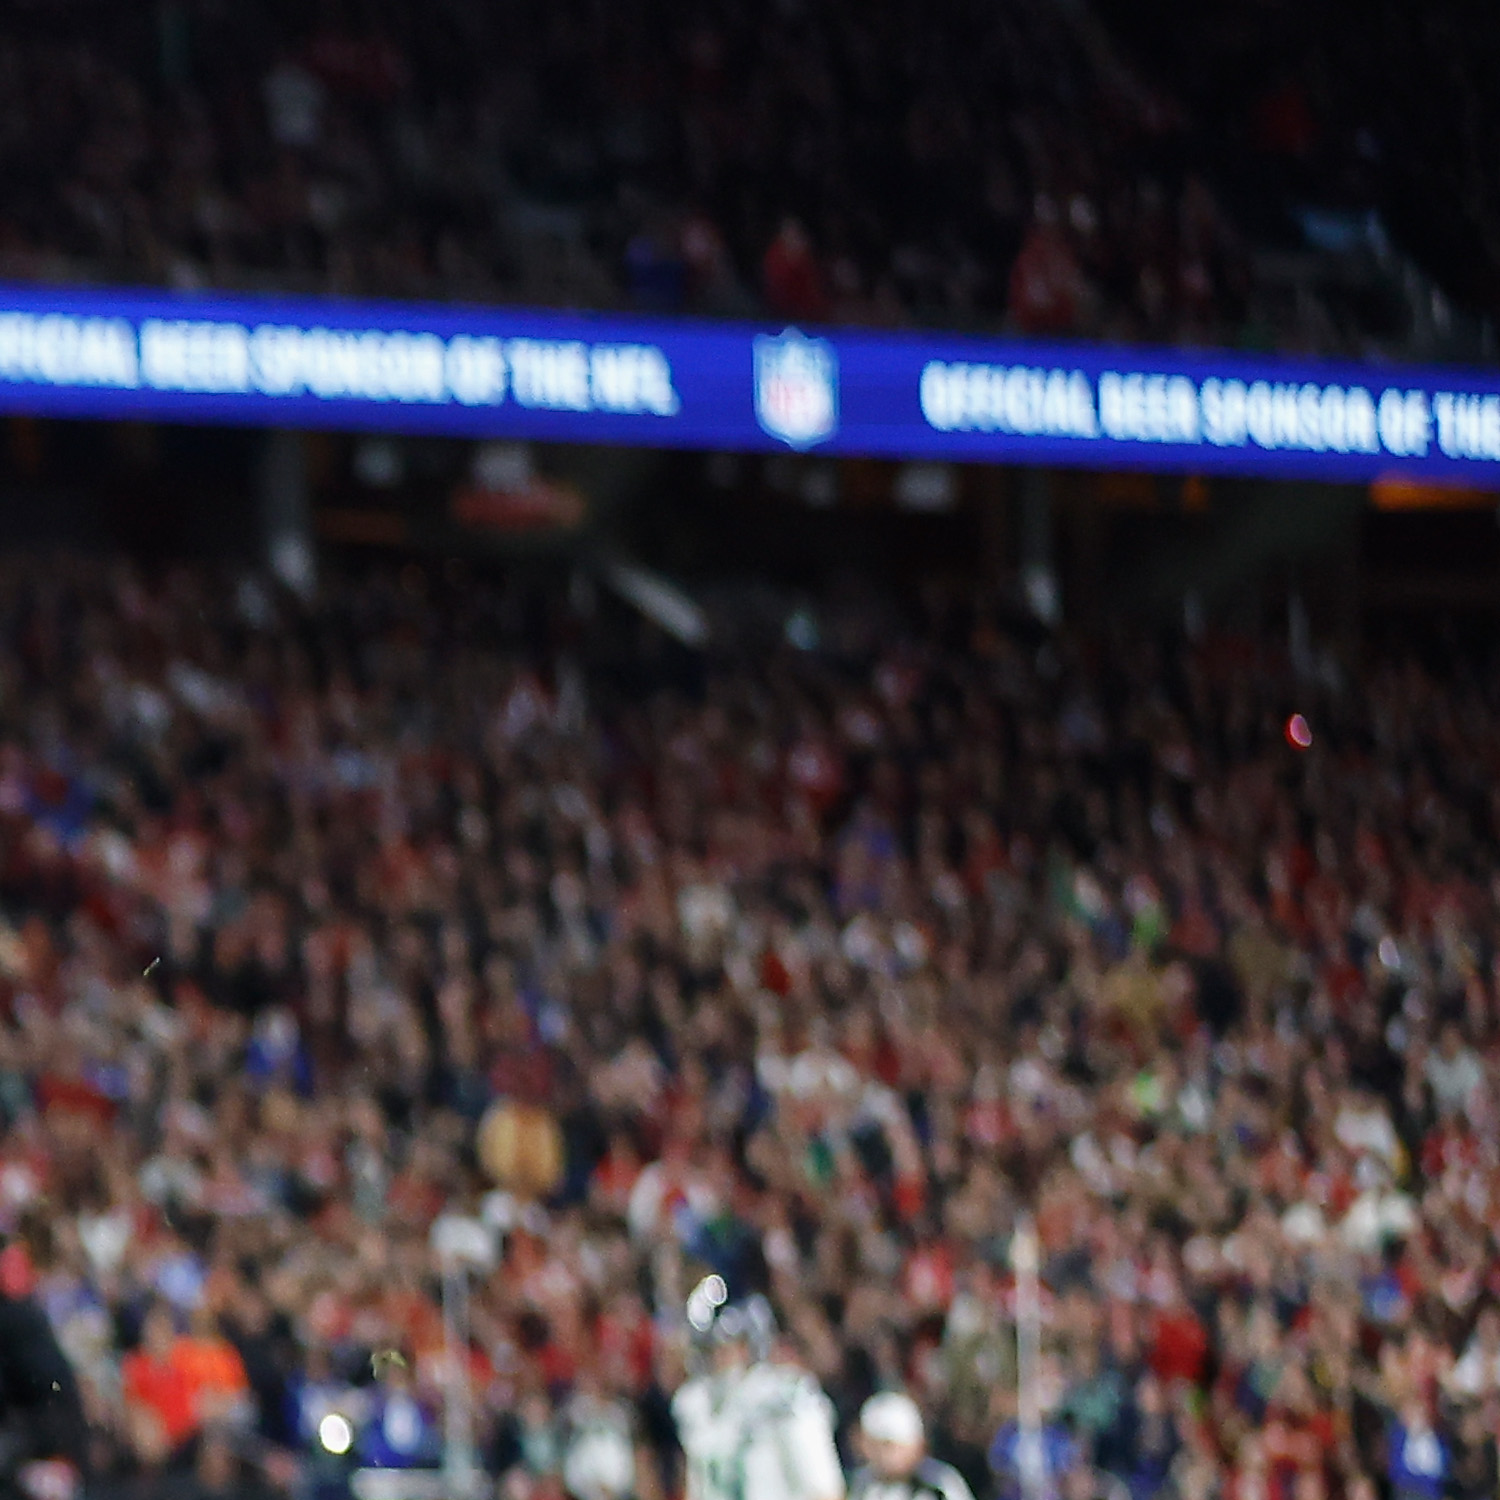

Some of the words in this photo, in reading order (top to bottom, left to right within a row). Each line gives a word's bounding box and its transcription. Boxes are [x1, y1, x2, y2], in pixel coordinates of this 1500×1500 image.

[922, 367, 1094, 433] OFFICIAL
[1100, 377, 1199, 439] BEER
[1199, 384, 1376, 449] SPONSOR
[1379, 393, 1428, 452] OF
